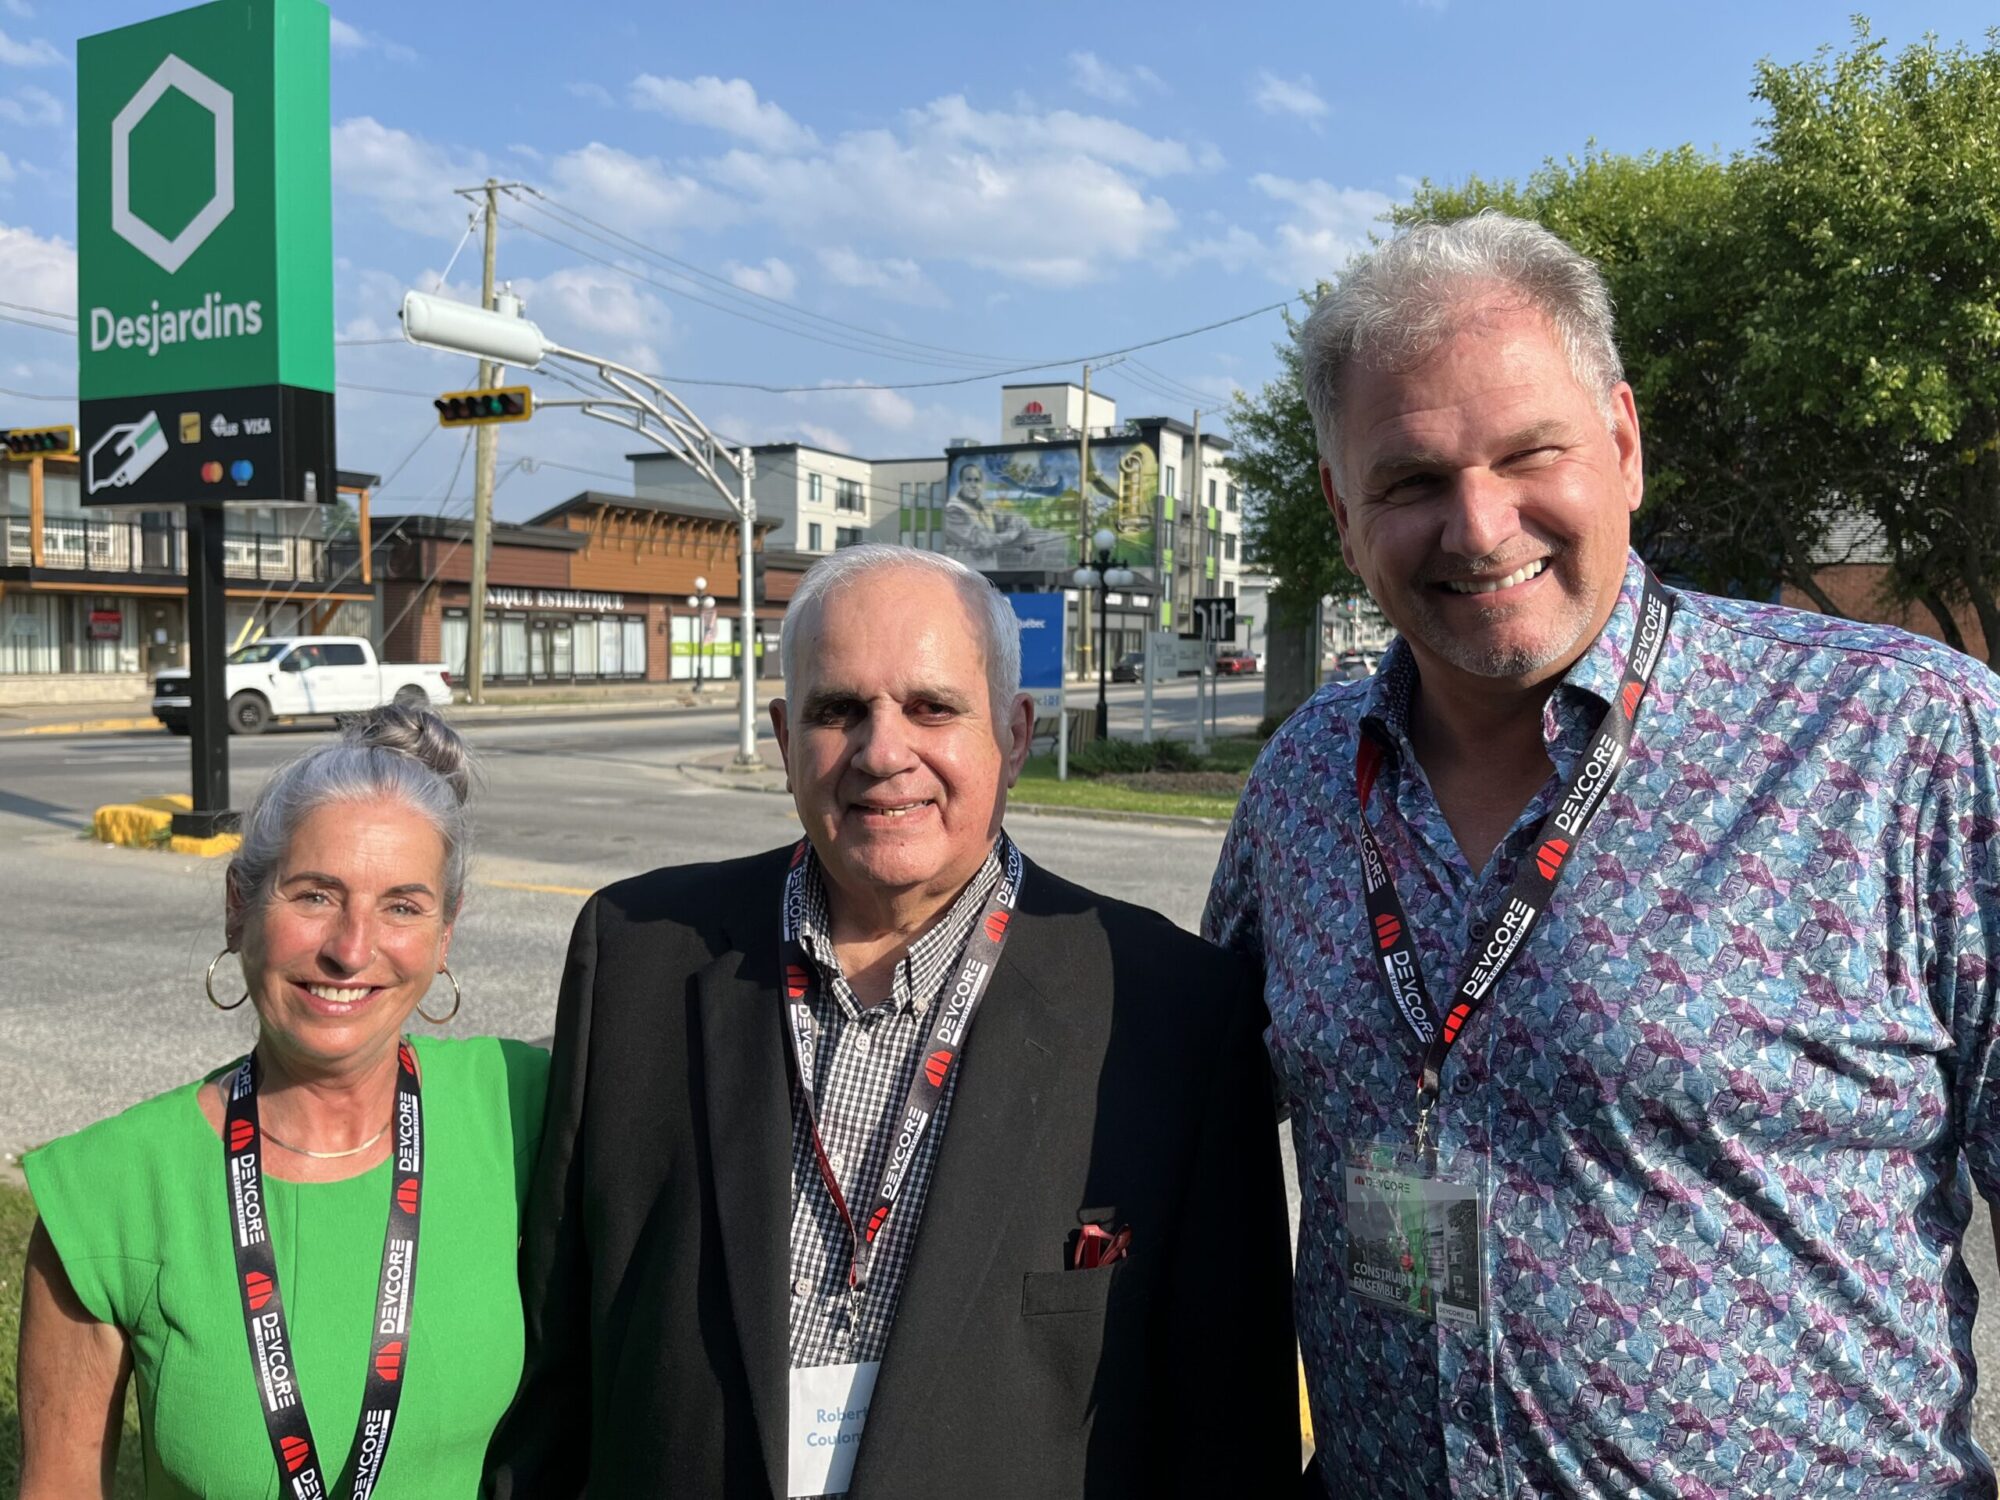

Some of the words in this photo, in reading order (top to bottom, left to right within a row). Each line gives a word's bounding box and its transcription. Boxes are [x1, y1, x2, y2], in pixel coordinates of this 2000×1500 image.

[91, 292, 263, 357] Desjardins
[243, 417, 272, 435] VISA
[485, 588, 533, 609] NIQUE
[537, 590, 624, 613] ESTHÉTIQUE
[1633, 593, 1661, 676] DEVCORE
[1555, 734, 1616, 830] DEVCORE
[1578, 788, 1600, 819] GROUPE
[1599, 761, 1616, 786] GROUP
[1360, 827, 1387, 890] VCORE
[790, 866, 802, 941] DEVCORE
[1462, 897, 1527, 996] DEVCORE
[1485, 956, 1507, 984] GROUPE
[1508, 925, 1525, 950] GROUP
[936, 957, 981, 1044] DEVCORE
[1388, 973, 1402, 1000] GROUPE
[1393, 950, 1438, 1045] DEVCORE
[798, 1004, 814, 1092] DEVCORE
[399, 1091, 412, 1172] DEVCORE
[881, 1106, 922, 1199] DEVCORE
[239, 1153, 266, 1246] DEVCORE
[1366, 1177, 1411, 1194] DEVCORE
[379, 1239, 406, 1335] DEVCORE
[1353, 1262, 1414, 1288] CONSTRUIRE
[1353, 1276, 1401, 1300] ENSEMBLE
[256, 1335, 268, 1363] GROUPE
[262, 1312, 296, 1409] DEVCORE
[816, 1406, 868, 1424] Robert
[353, 1410, 382, 1500] DEVCORE
